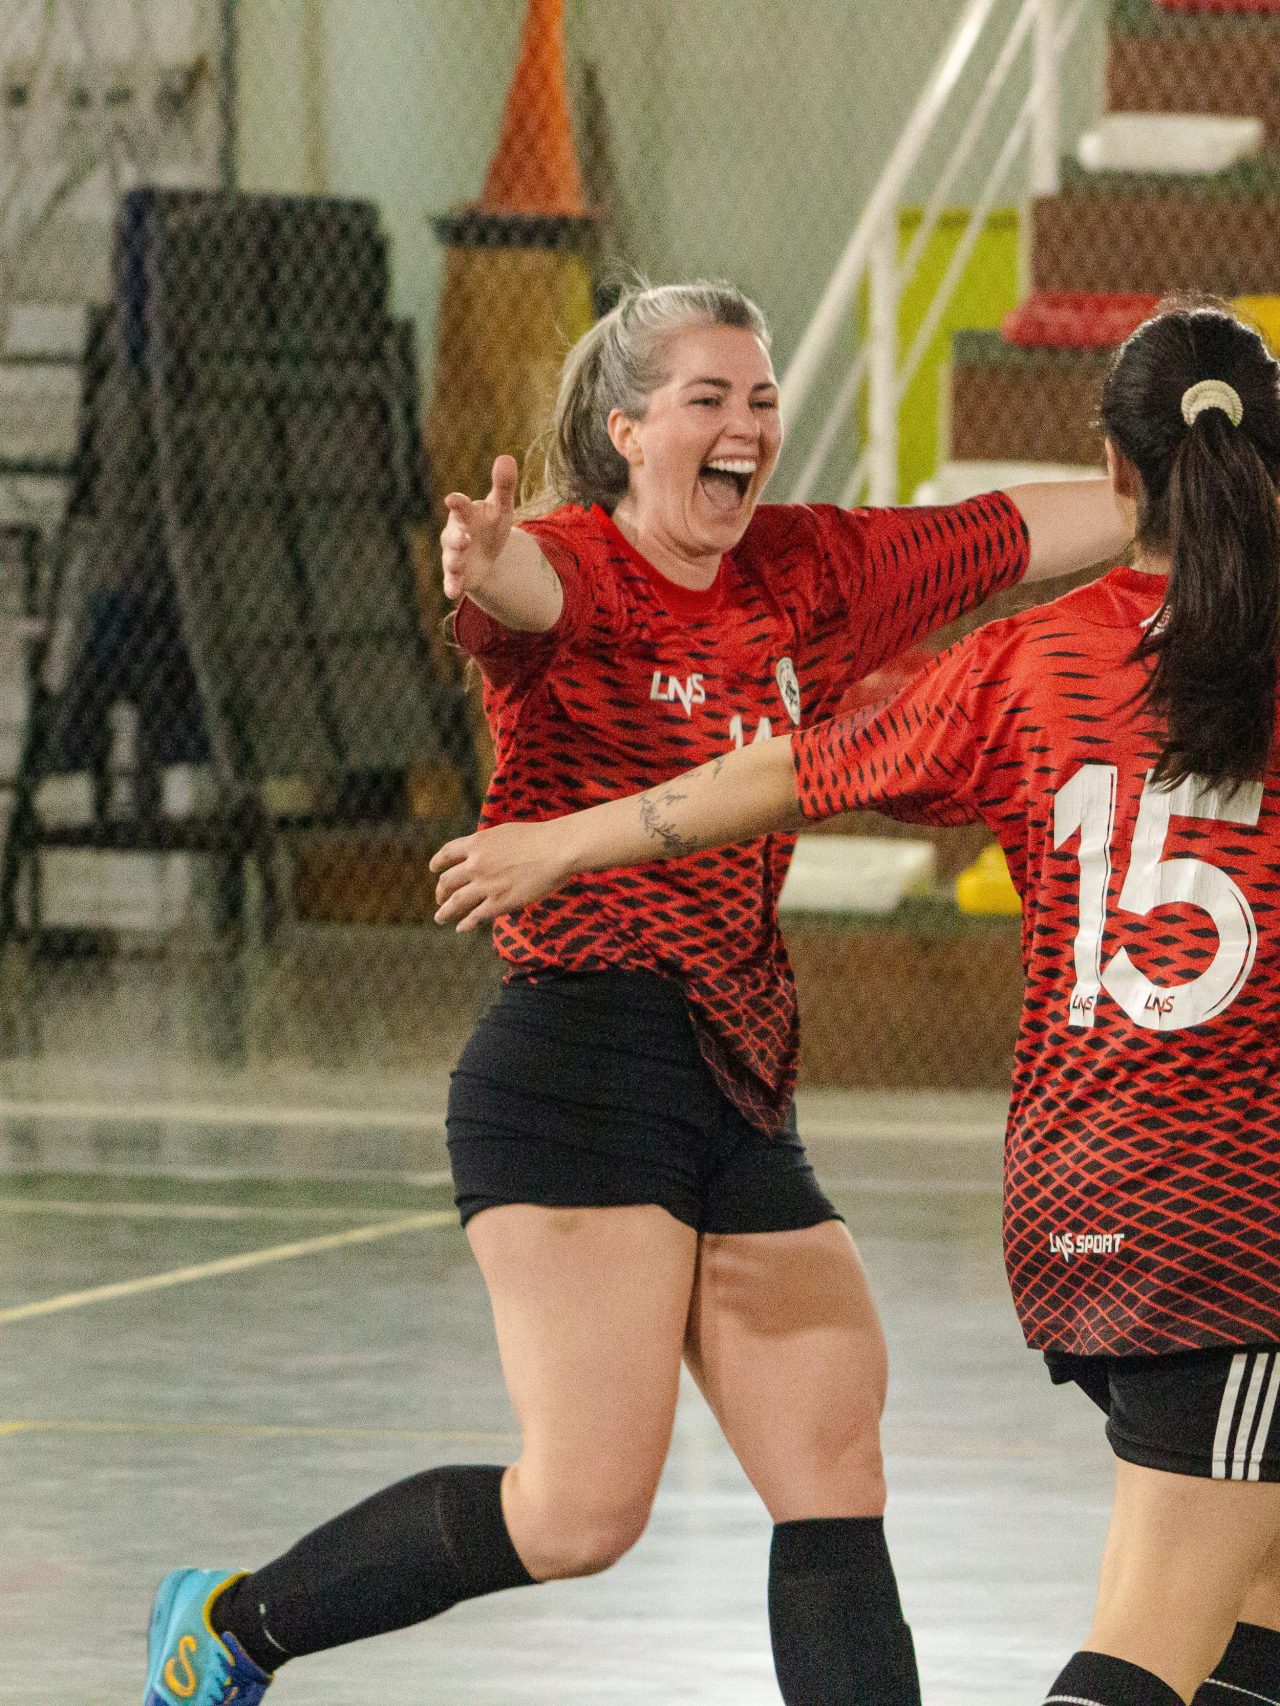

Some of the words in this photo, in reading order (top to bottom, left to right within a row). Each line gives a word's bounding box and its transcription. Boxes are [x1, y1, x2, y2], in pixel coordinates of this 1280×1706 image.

[650, 670, 706, 717] LNS
[1053, 763, 1264, 1031] 15
[1072, 994, 1094, 1017] LNS
[1144, 993, 1175, 1017] LNS
[1049, 1232, 1075, 1263] LNS
[1076, 1233, 1125, 1253] SPORT
